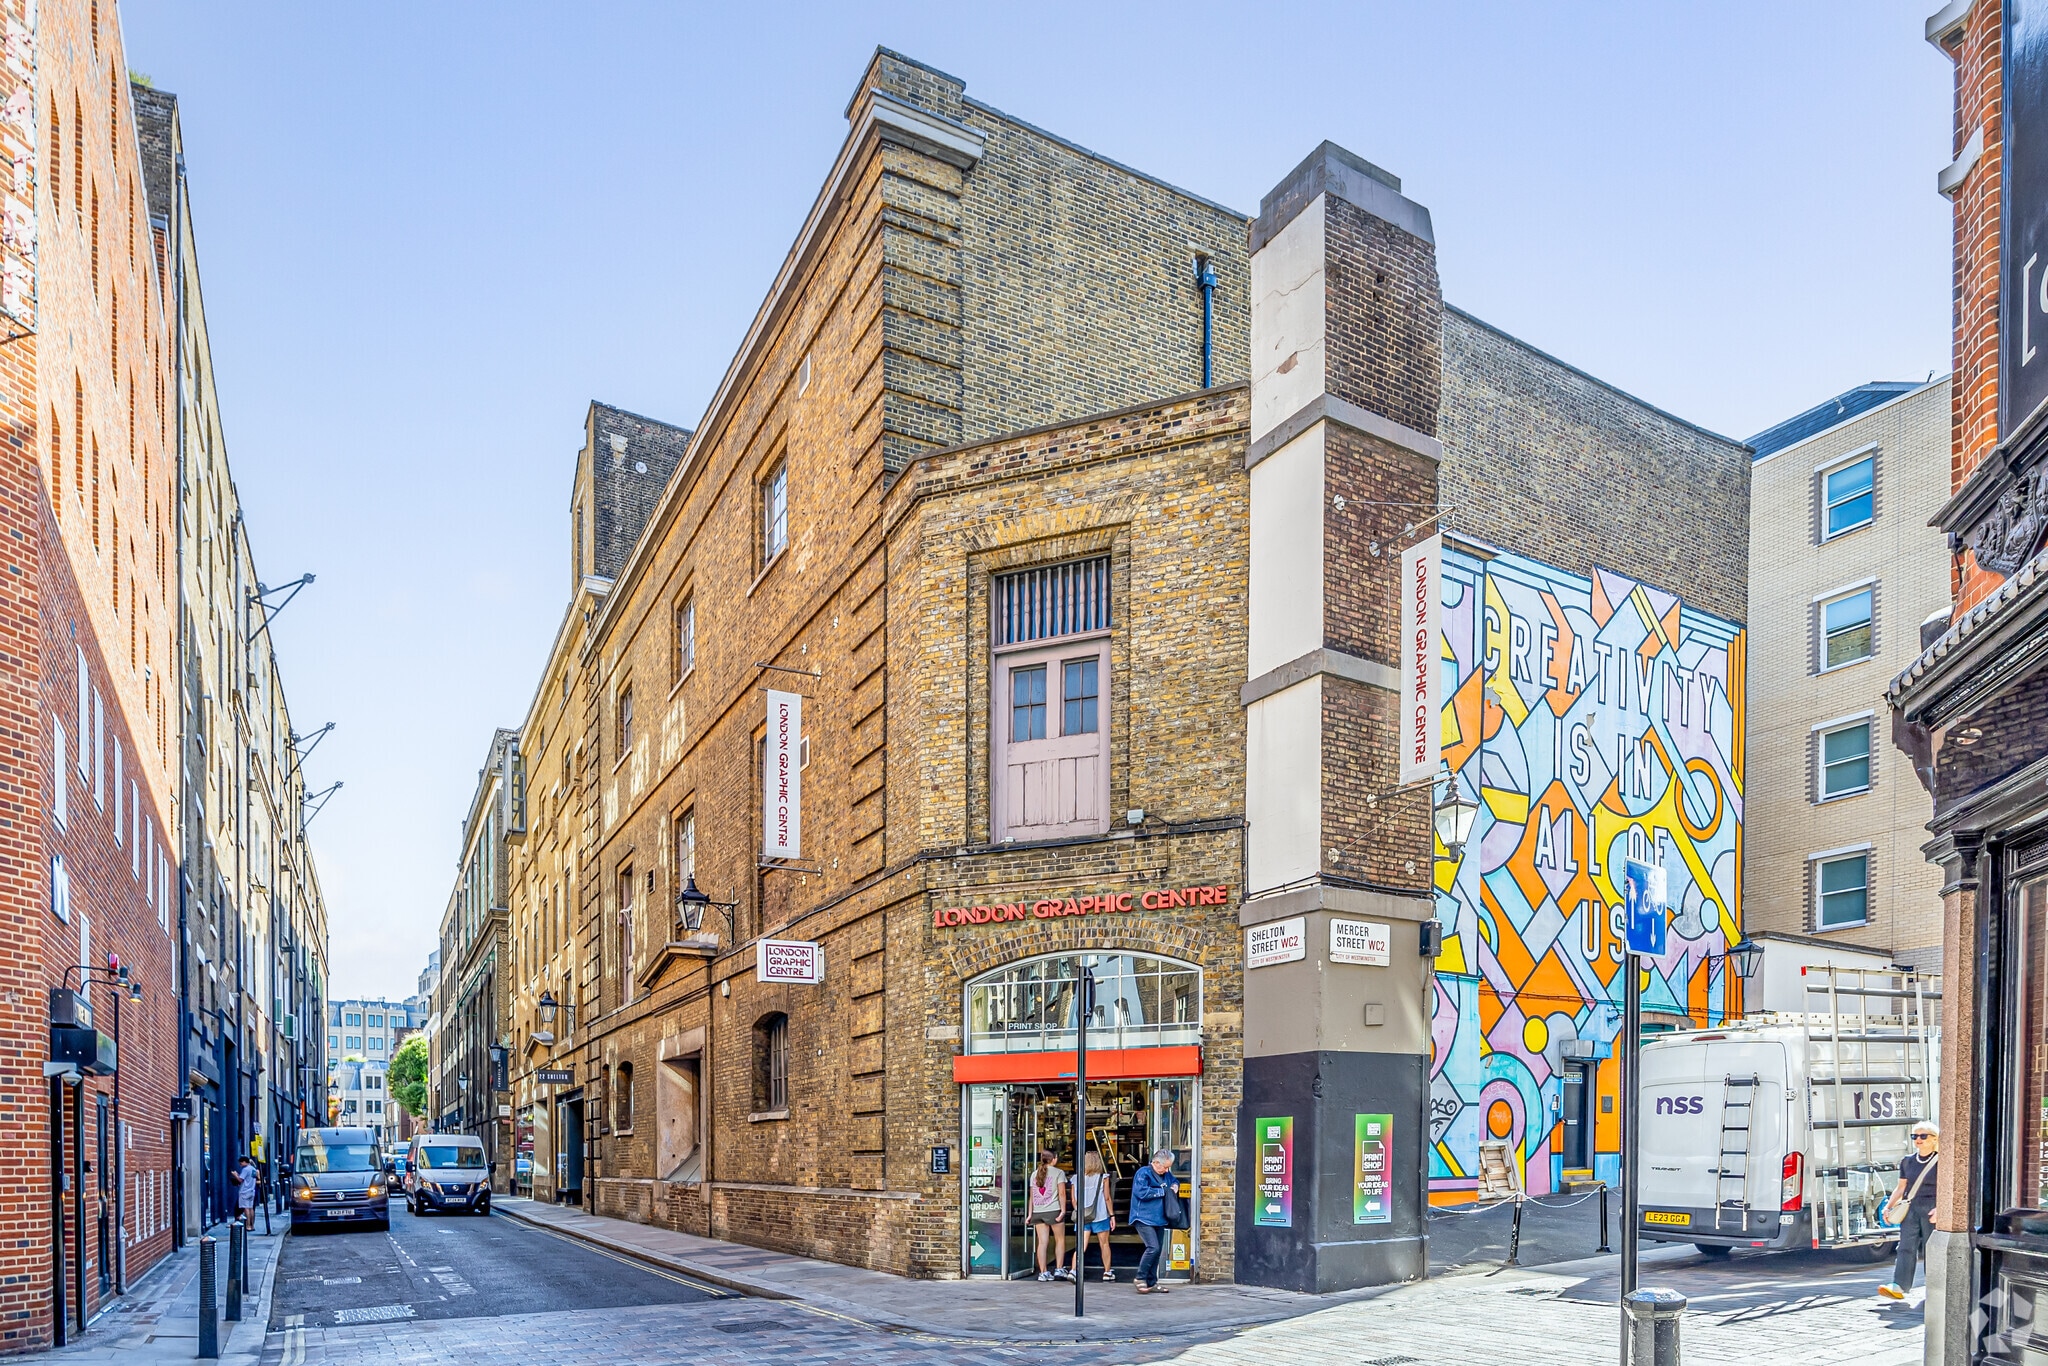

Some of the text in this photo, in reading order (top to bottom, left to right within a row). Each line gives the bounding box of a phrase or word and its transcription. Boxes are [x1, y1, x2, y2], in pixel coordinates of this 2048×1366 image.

[1415, 557, 1427, 764] LONDON GRAPHIC CENTRE
[1485, 605, 1718, 734] CREATIVITY
[1554, 716, 1652, 801] IS IN
[778, 703, 789, 847] LONDON GRAPHIC CENTRE
[1534, 804, 1669, 876] ALL OF
[934, 885, 1227, 928] LONDON GRAPHIC CENTRE
[1252, 925, 1285, 942] SHELTON
[1336, 924, 1369, 937] MERCER
[1580, 898, 1626, 964] US
[1251, 935, 1299, 954] STREET WC2
[1336, 937, 1385, 952] STREET WC2
[769, 947, 809, 957] LONDON
[769, 957, 811, 967] GRAPHIC
[1265, 953, 1290, 963] WESTMINSTER
[1350, 955, 1376, 963] WESTMINSTER
[769, 966, 804, 976] CENTRE
[1008, 1022, 1033, 1030] PRINT
[1656, 1096, 1704, 1115] nss
[1264, 1156, 1284, 1164] PRINT
[1364, 1153, 1383, 1161] PRINT
[1264, 1164, 1283, 1172] SHOP
[1363, 1161, 1382, 1169] SHOP
[969, 1177, 992, 1186] HOP
[1273, 1184, 1289, 1192] IDEAS
[969, 1194, 983, 1202] ING
[970, 1202, 1004, 1211] UR IDEAS
[971, 1211, 986, 1219] LIFE
[1648, 1213, 1686, 1223] LE23 GGA
